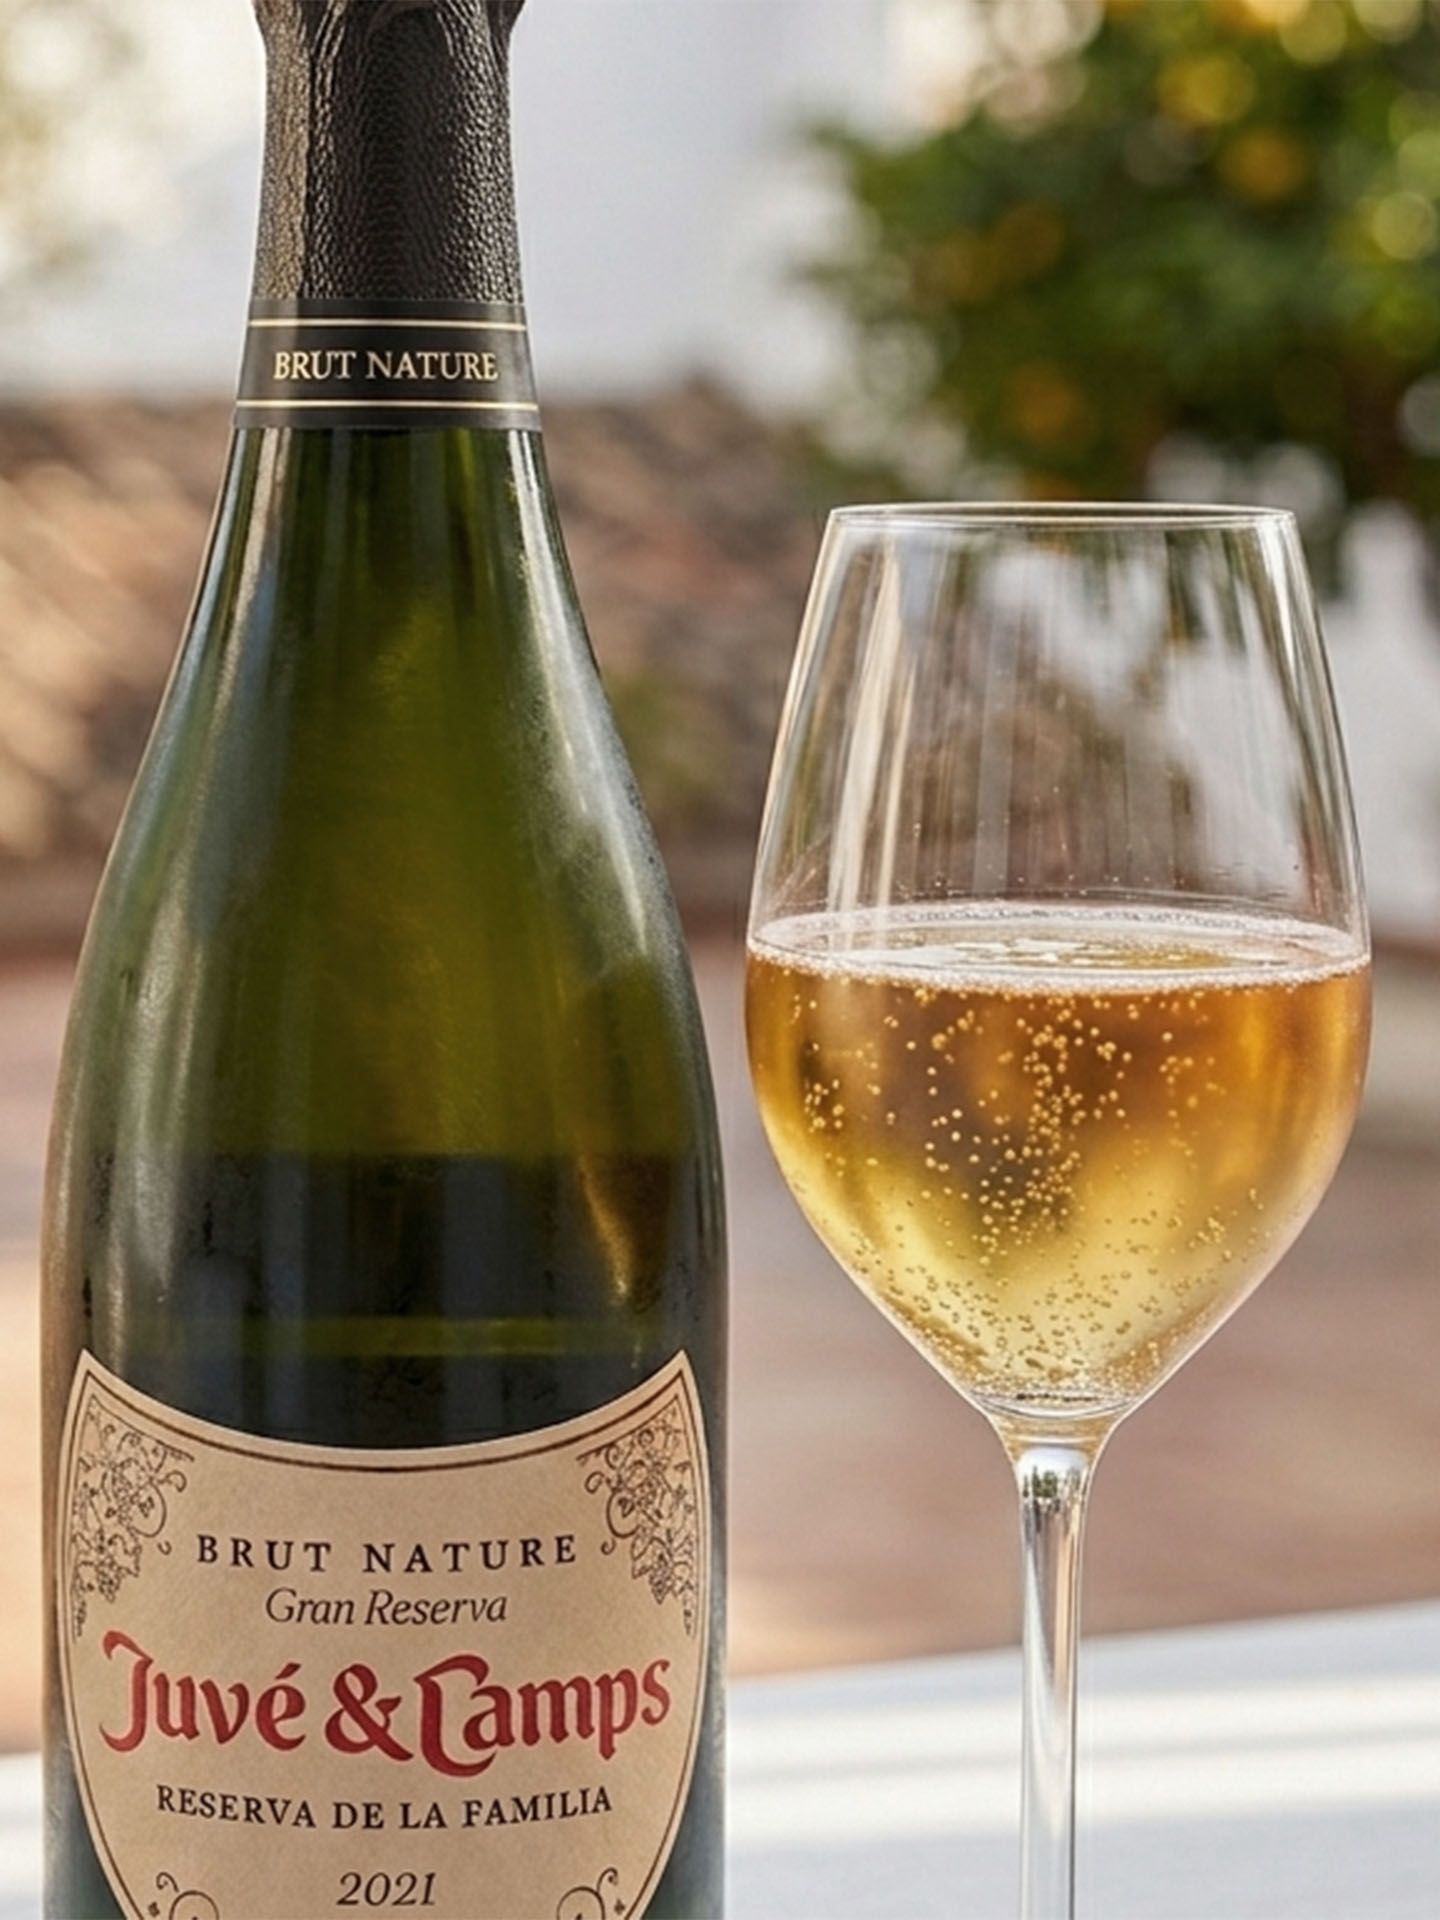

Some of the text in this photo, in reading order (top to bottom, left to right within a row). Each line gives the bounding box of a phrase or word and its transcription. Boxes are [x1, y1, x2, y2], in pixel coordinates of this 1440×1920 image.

[273, 350, 499, 381] BRUT NATURE
[197, 1534, 577, 1574] BRUT NATURE
[265, 1587, 508, 1627] Gran Reserva
[99, 1630, 672, 1778] Juvé & Camps
[155, 1785, 613, 1830] RESERVA DE LA FAMILIA
[335, 1872, 437, 1909] 2021
